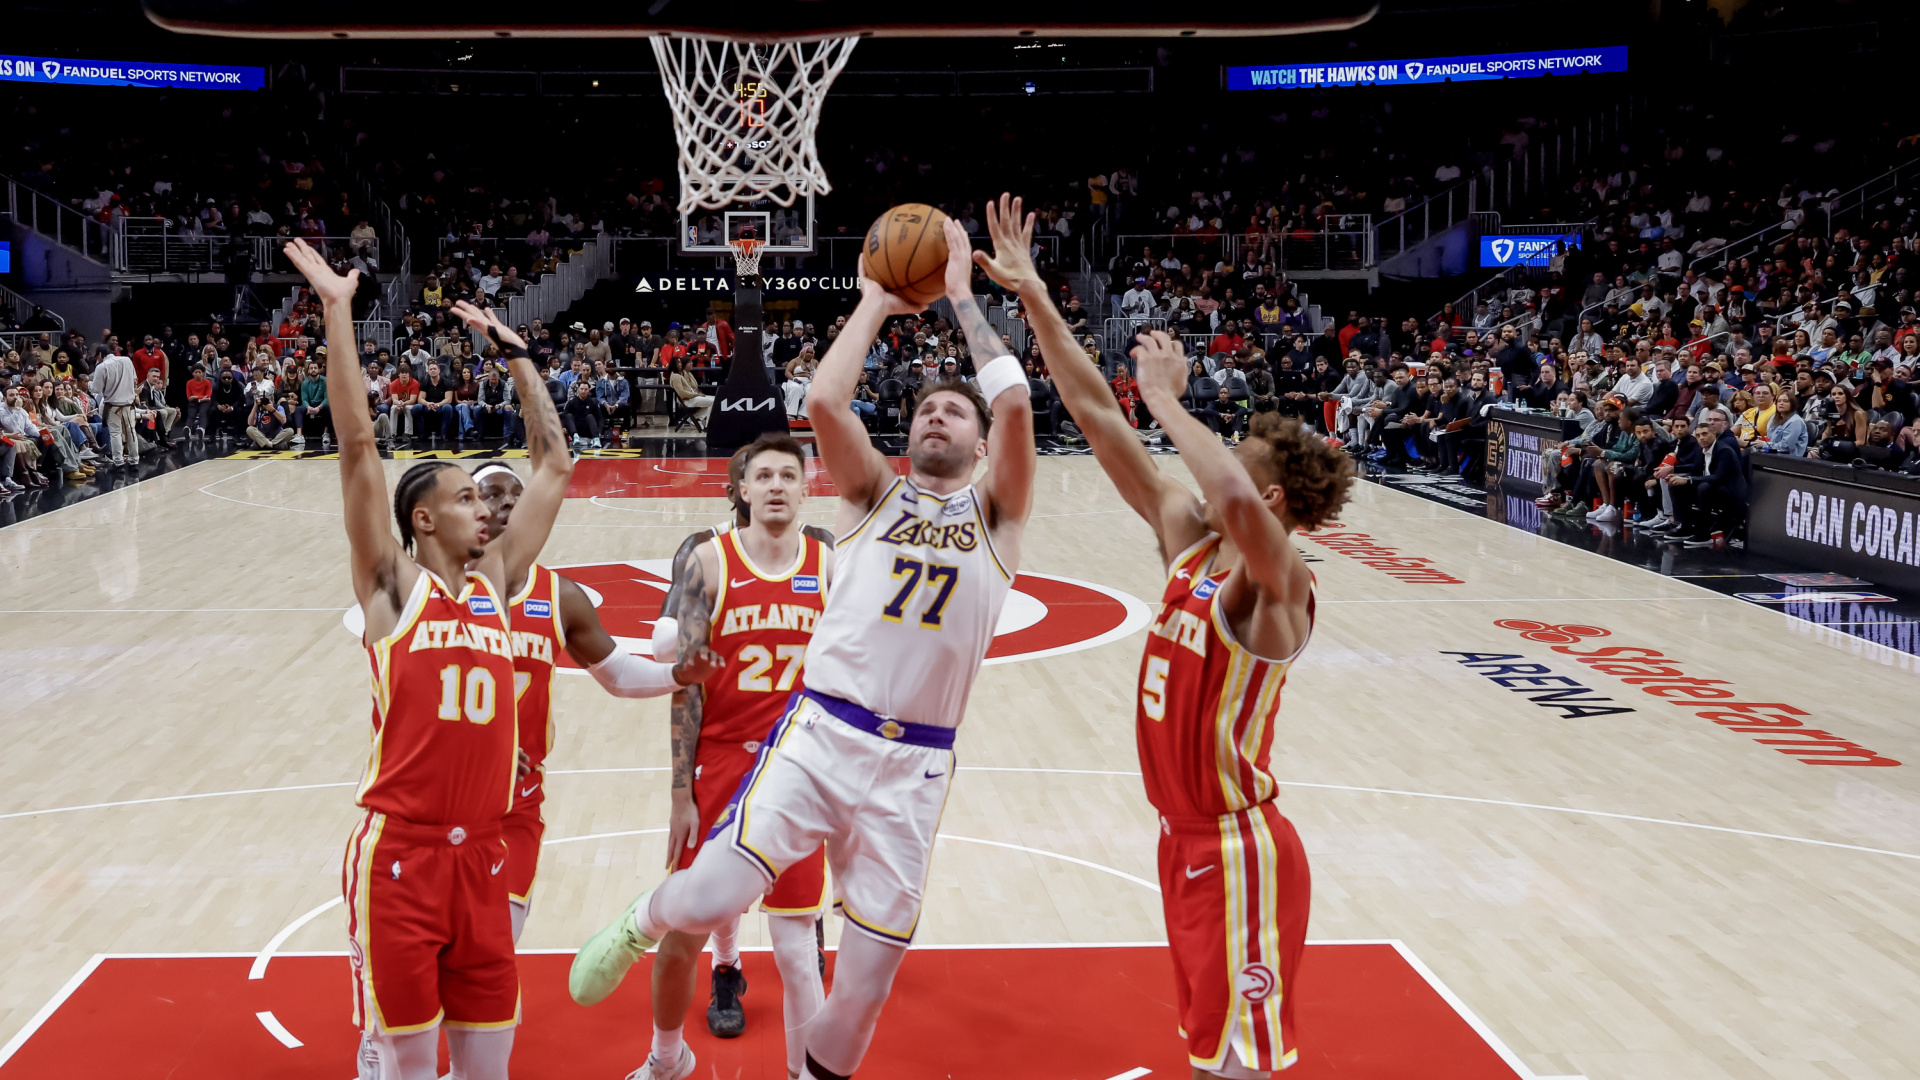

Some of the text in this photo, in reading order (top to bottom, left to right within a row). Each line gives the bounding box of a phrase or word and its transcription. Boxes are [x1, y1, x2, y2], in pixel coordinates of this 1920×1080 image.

[15, 60, 35, 77] ON
[63, 66, 126, 79] FANDUEL
[128, 69, 177, 81] SPORTS
[180, 71, 241, 84] NETWORK
[1250, 55, 1602, 85] WATCH THE HAWKS ON FANDUEL SPORTS NETWORK
[659, 277, 730, 291] DELTA
[875, 509, 978, 552] LAKERS
[1785, 488, 1845, 549] GRAN
[794, 578, 817, 588] paze
[881, 555, 960, 631] 77
[526, 602, 549, 612] paze
[737, 644, 808, 693] 27
[1142, 654, 1170, 723] 5
[1438, 650, 1637, 719] ARENA
[438, 663, 496, 725] 10
